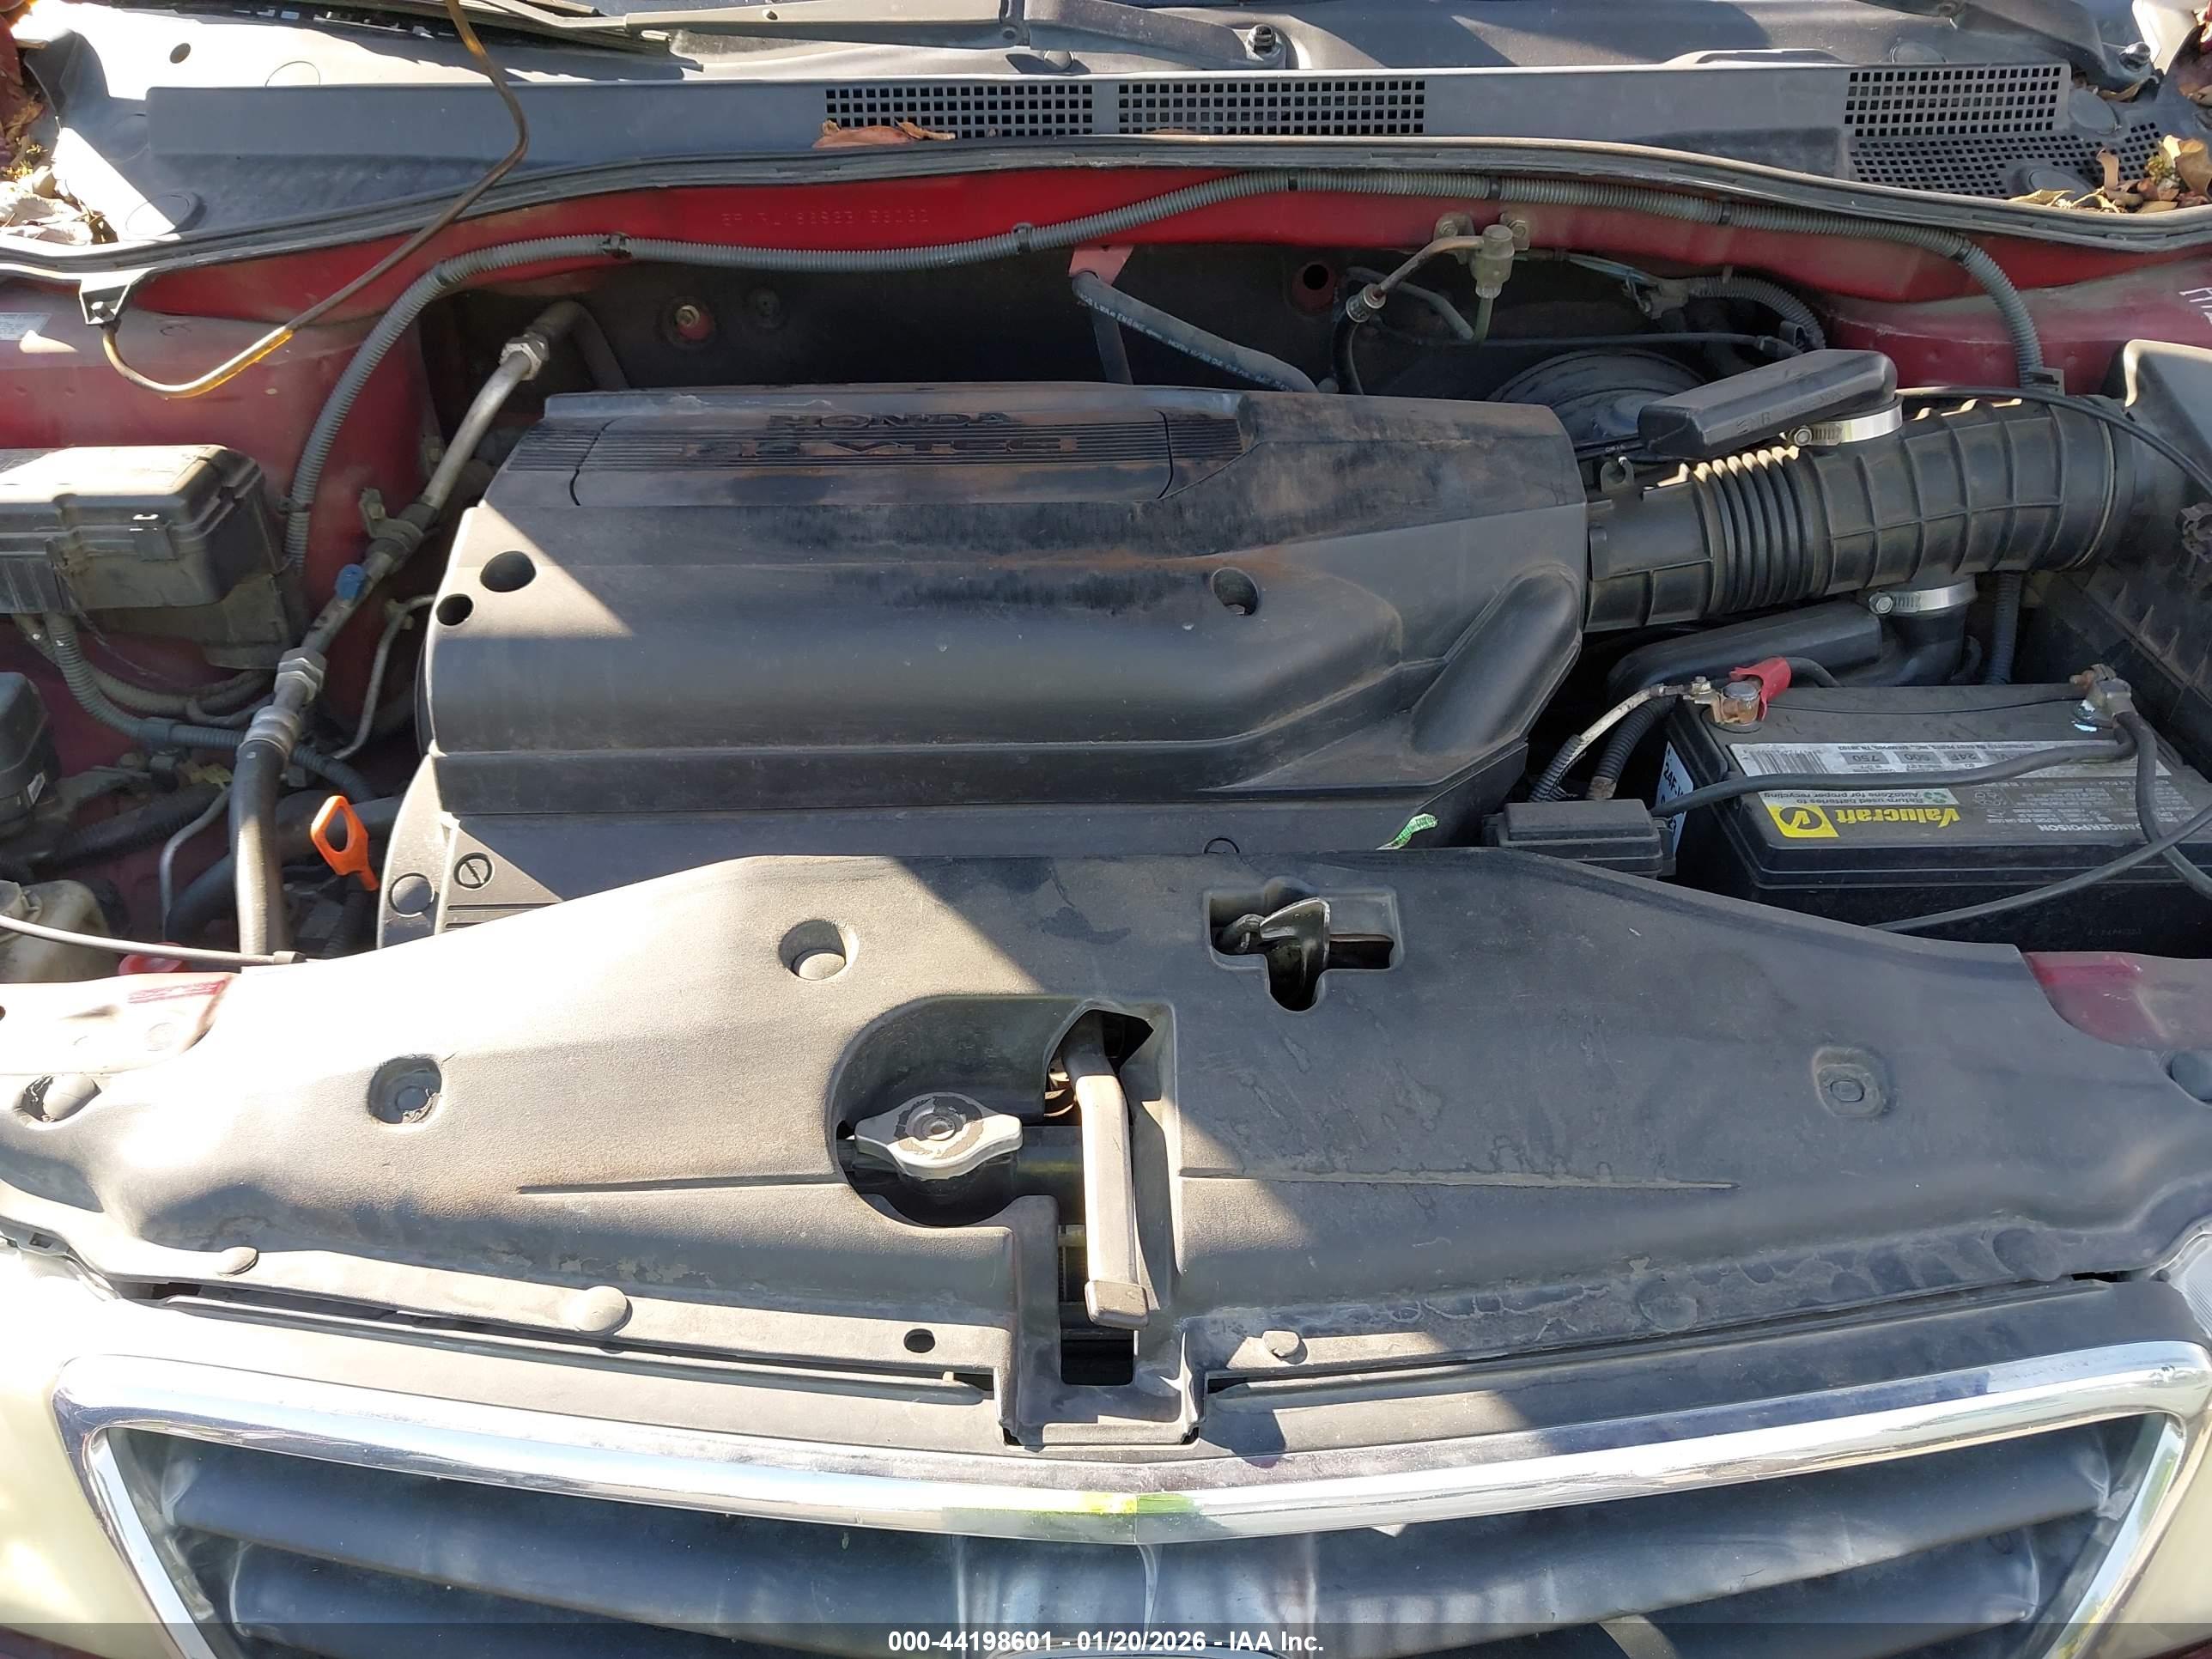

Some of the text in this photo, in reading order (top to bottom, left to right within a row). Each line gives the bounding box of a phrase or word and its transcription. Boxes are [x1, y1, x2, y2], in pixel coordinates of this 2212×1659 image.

[769, 412, 1019, 428] HONDA
[1852, 754, 1881, 763] 750
[1951, 752, 1977, 762] 24F
[1836, 808, 1960, 829] Valucraft
